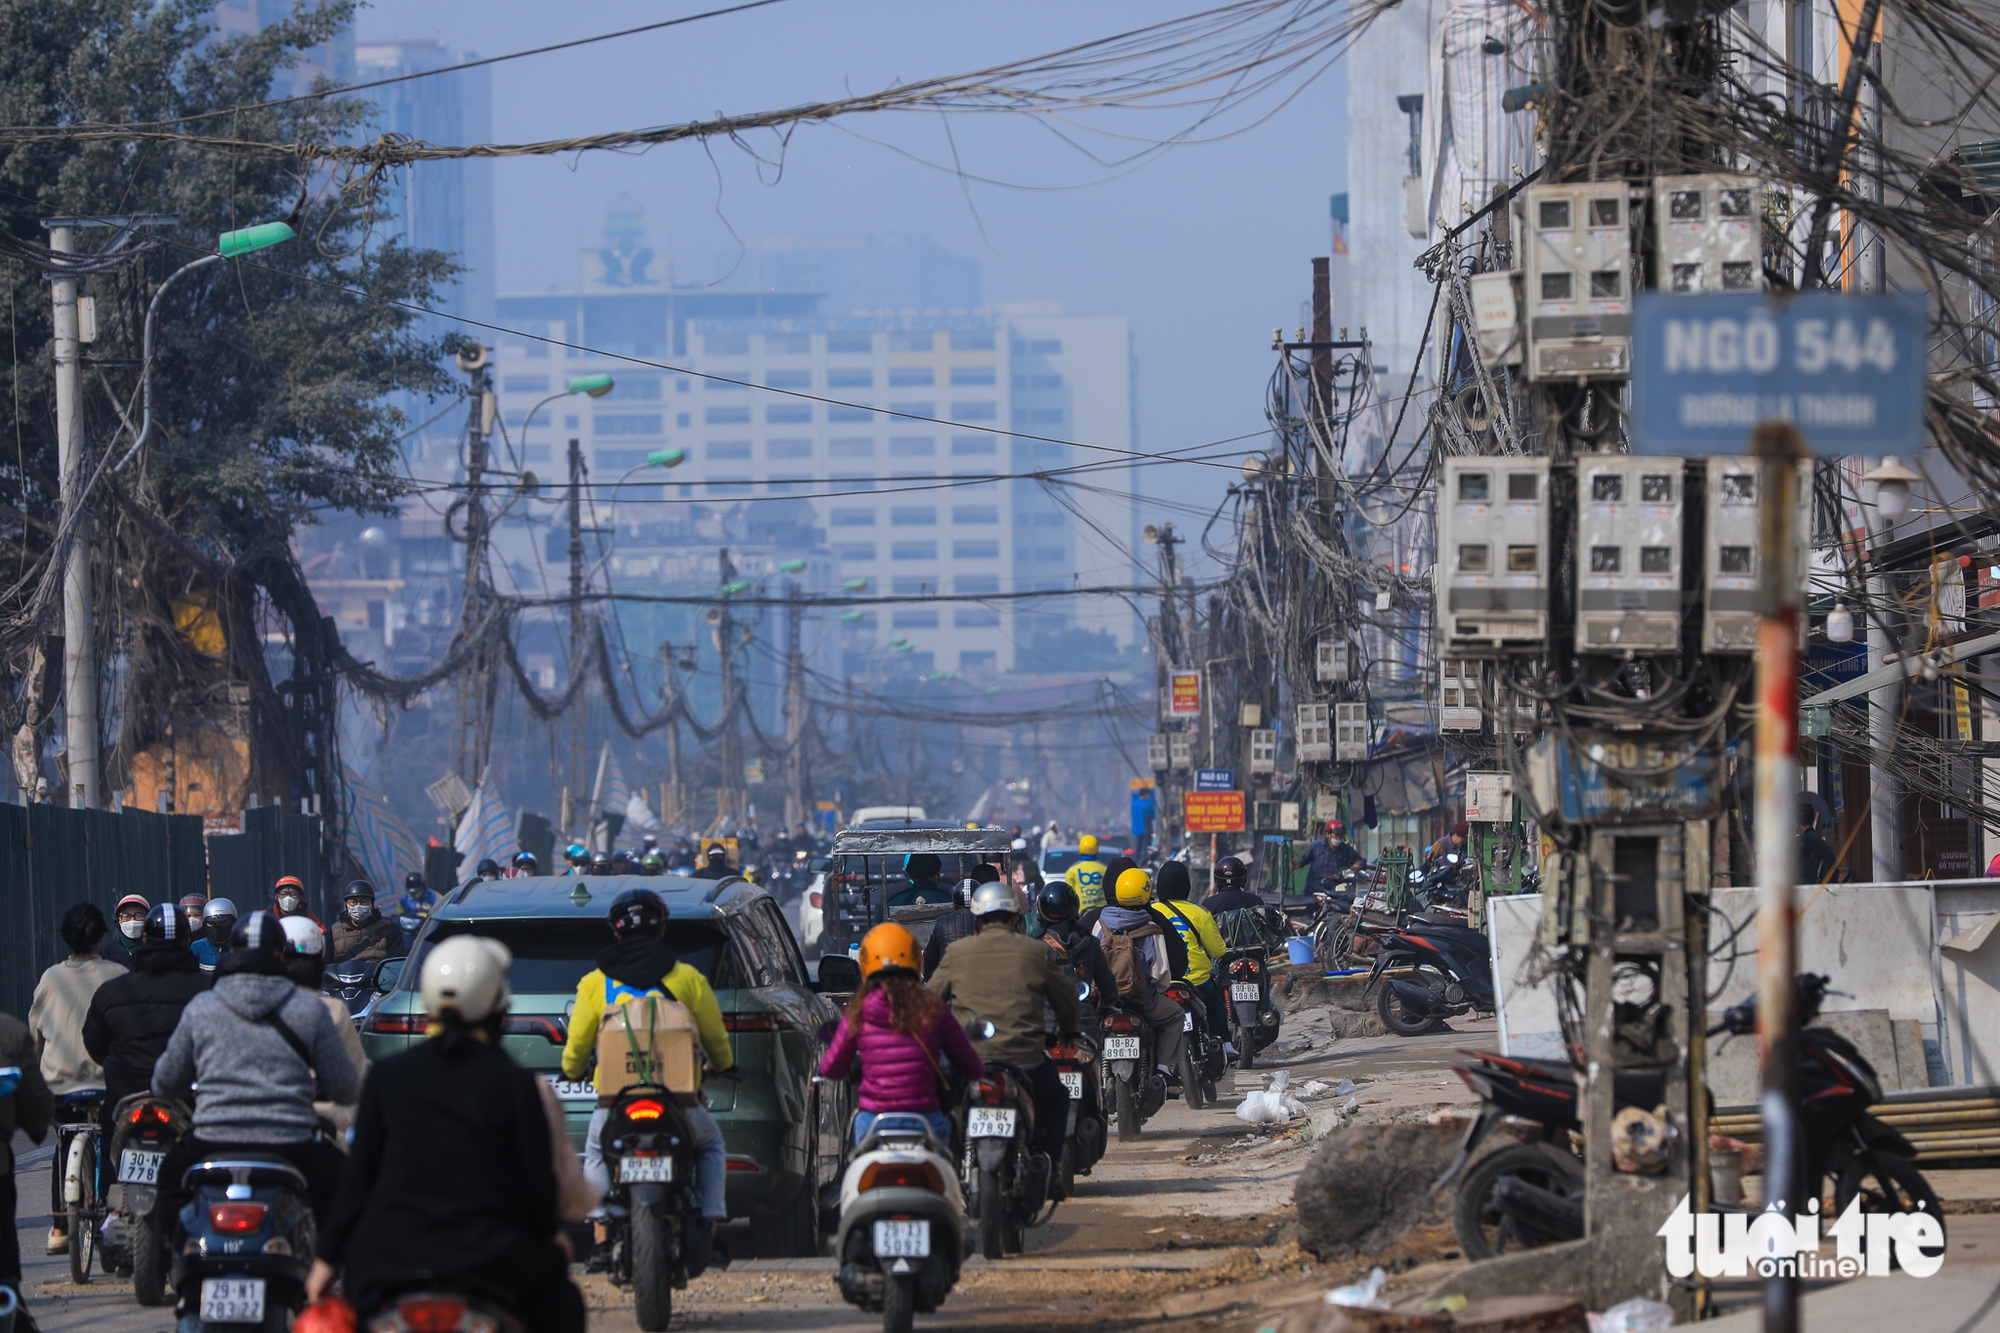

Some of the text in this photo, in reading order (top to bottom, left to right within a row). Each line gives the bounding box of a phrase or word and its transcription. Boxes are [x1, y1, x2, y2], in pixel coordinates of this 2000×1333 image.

[1663, 307, 1897, 374] NGÕ 544
[1838, 658, 1859, 672] LONG
[1078, 868, 1102, 886] be
[1111, 1038, 1135, 1048] 18-B2
[1107, 1048, 1138, 1058] 896.10
[977, 1109, 1008, 1121] 36-B4
[972, 1121, 1012, 1135] 978.97
[883, 1239, 922, 1255] 5092
